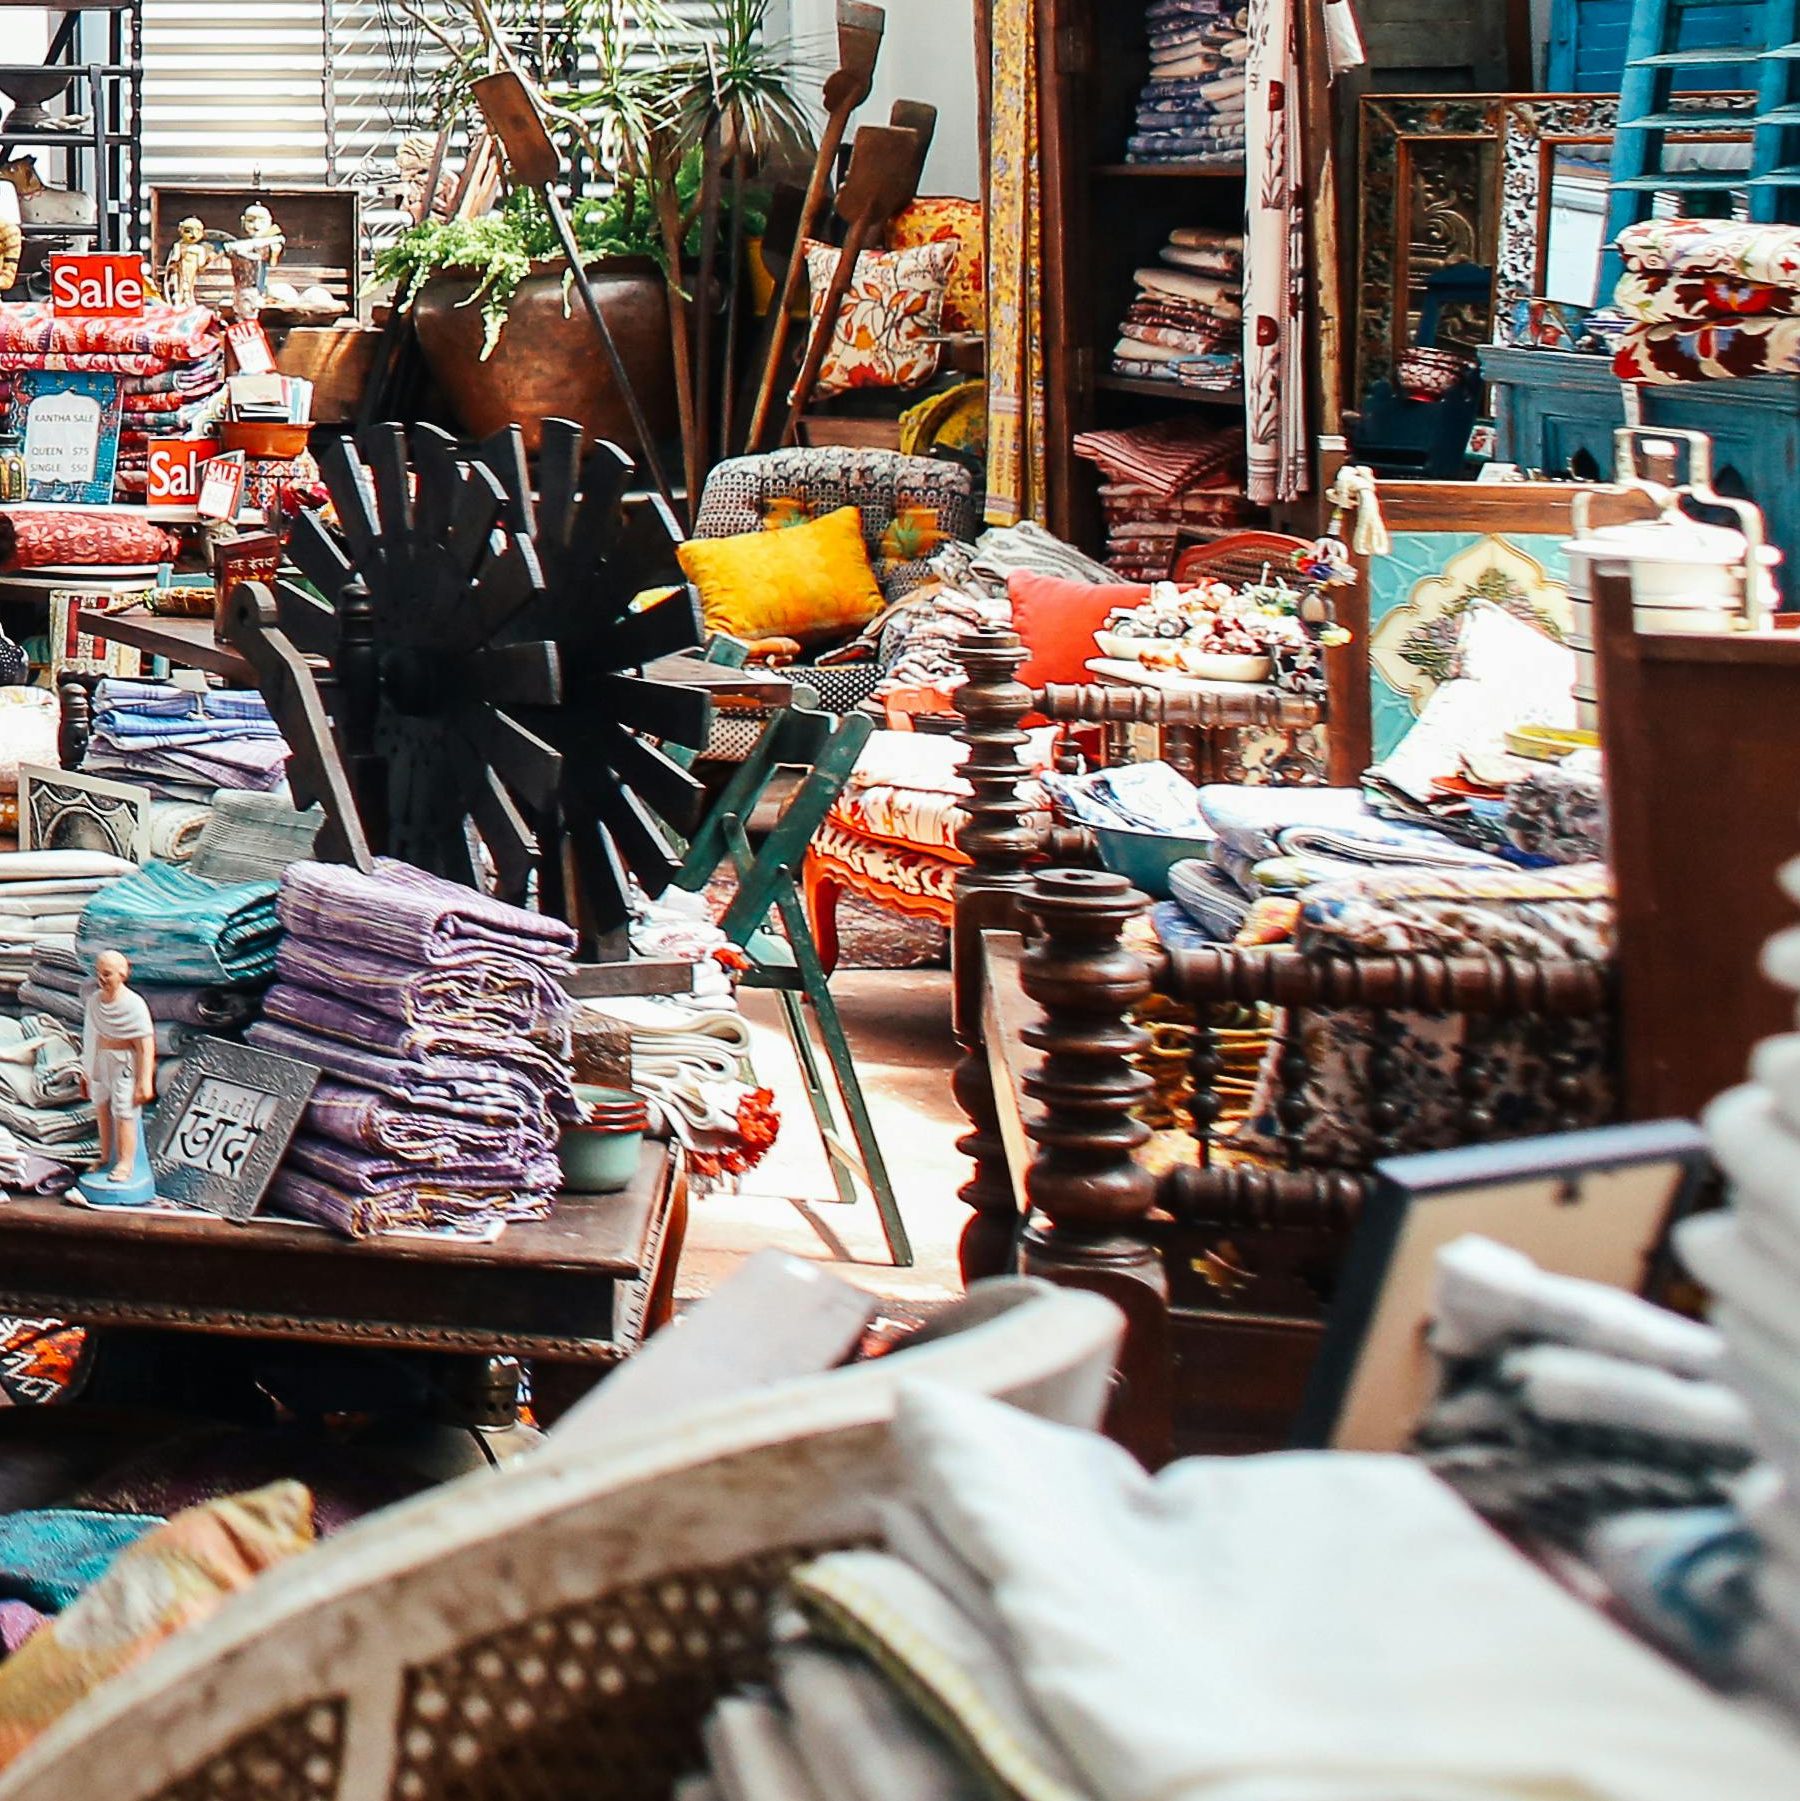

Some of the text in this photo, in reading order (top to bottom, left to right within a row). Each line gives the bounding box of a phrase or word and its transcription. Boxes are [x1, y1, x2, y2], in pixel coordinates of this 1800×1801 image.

[54, 265, 142, 309] Sale
[227, 321, 260, 345] SALE
[34, 413, 96, 423] KANTHA SALE
[31, 446, 63, 456] QUEEN
[30, 463, 61, 473] SINGLE
[149, 450, 199, 497] Sal
[206, 460, 239, 484] SALE
